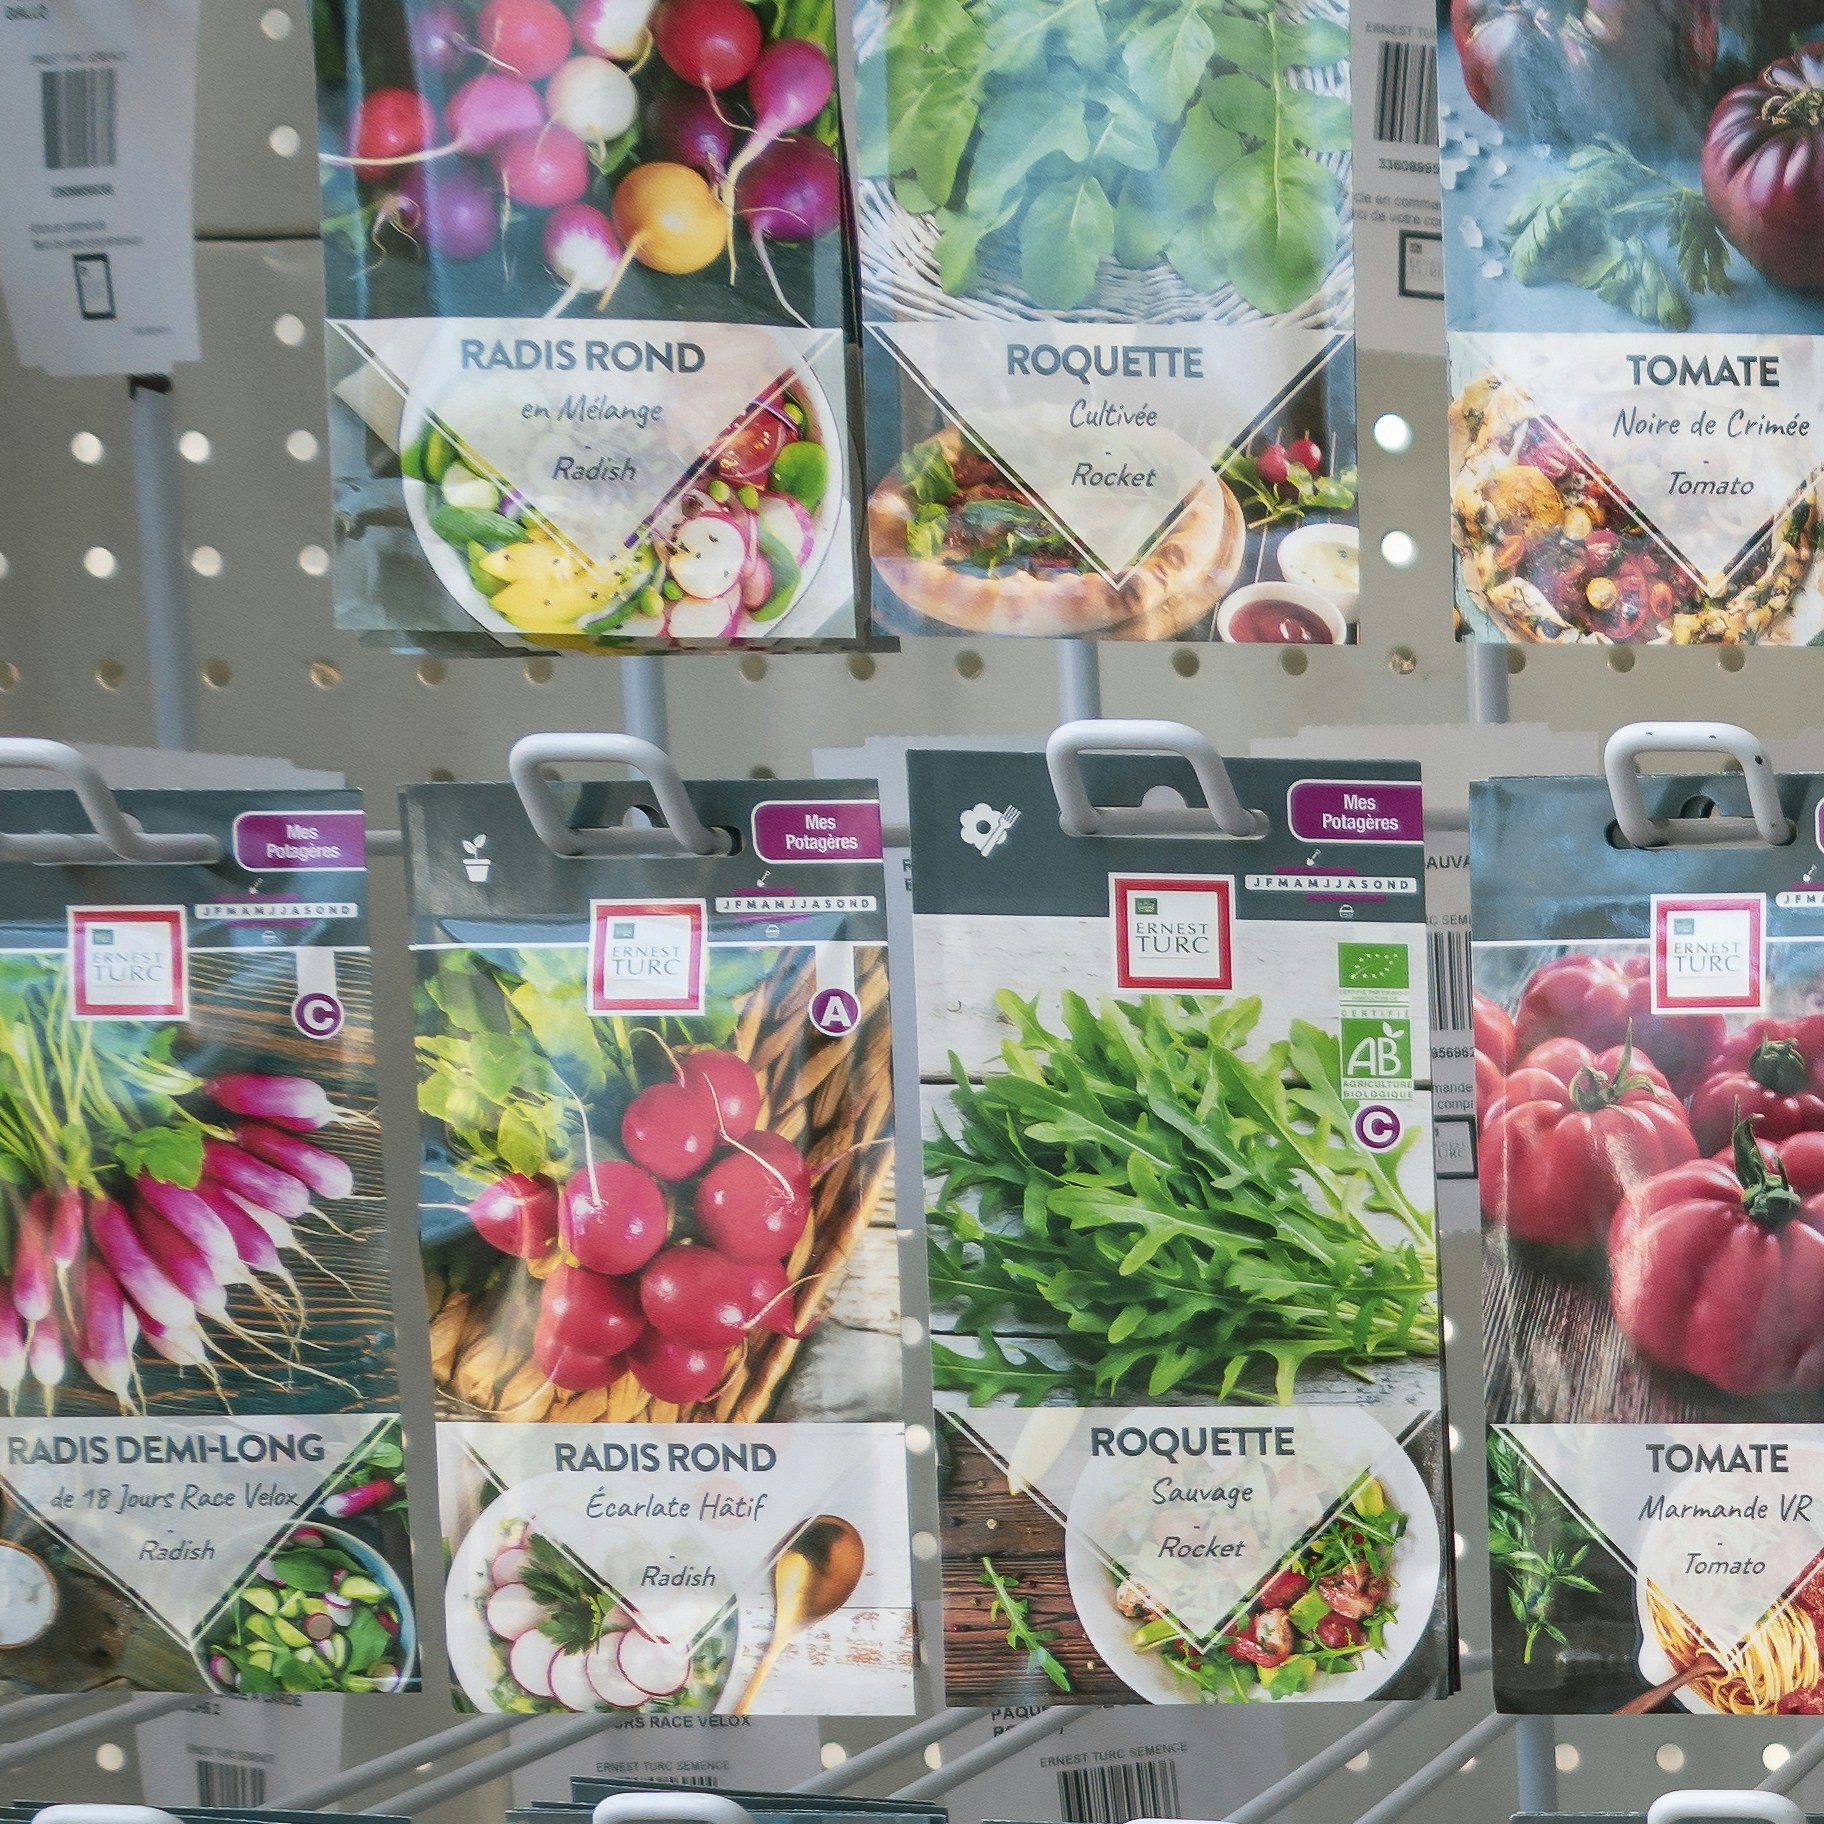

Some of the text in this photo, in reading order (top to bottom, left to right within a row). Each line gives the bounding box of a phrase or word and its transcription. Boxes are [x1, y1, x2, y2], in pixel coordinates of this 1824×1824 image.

[462, 340, 704, 373] RADIS ROND
[1007, 344, 1203, 379] ROQUETTE
[1626, 354, 1779, 387] TOMATE
[522, 397, 662, 426] en Mélange
[1069, 399, 1157, 429] Cultivée
[1612, 410, 1810, 439] Noire de Crimée
[805, 814, 836, 830] Mes
[786, 833, 858, 853] Potagères
[1136, 922, 1208, 936] ERNEST
[1136, 935, 1208, 955] TURC
[8, 1433, 324, 1466] RADIS DEMI-LONG
[1090, 1427, 1295, 1458] ROQUETTE
[554, 1443, 776, 1472] RADIS ROND
[1645, 1444, 1788, 1474] TOMATE
[586, 1489, 765, 1521] Écarlate Hâtif
[1151, 1479, 1253, 1507] Sauvage
[1638, 1493, 1812, 1524] Marmande VR
[139, 1539, 214, 1562] Radish
